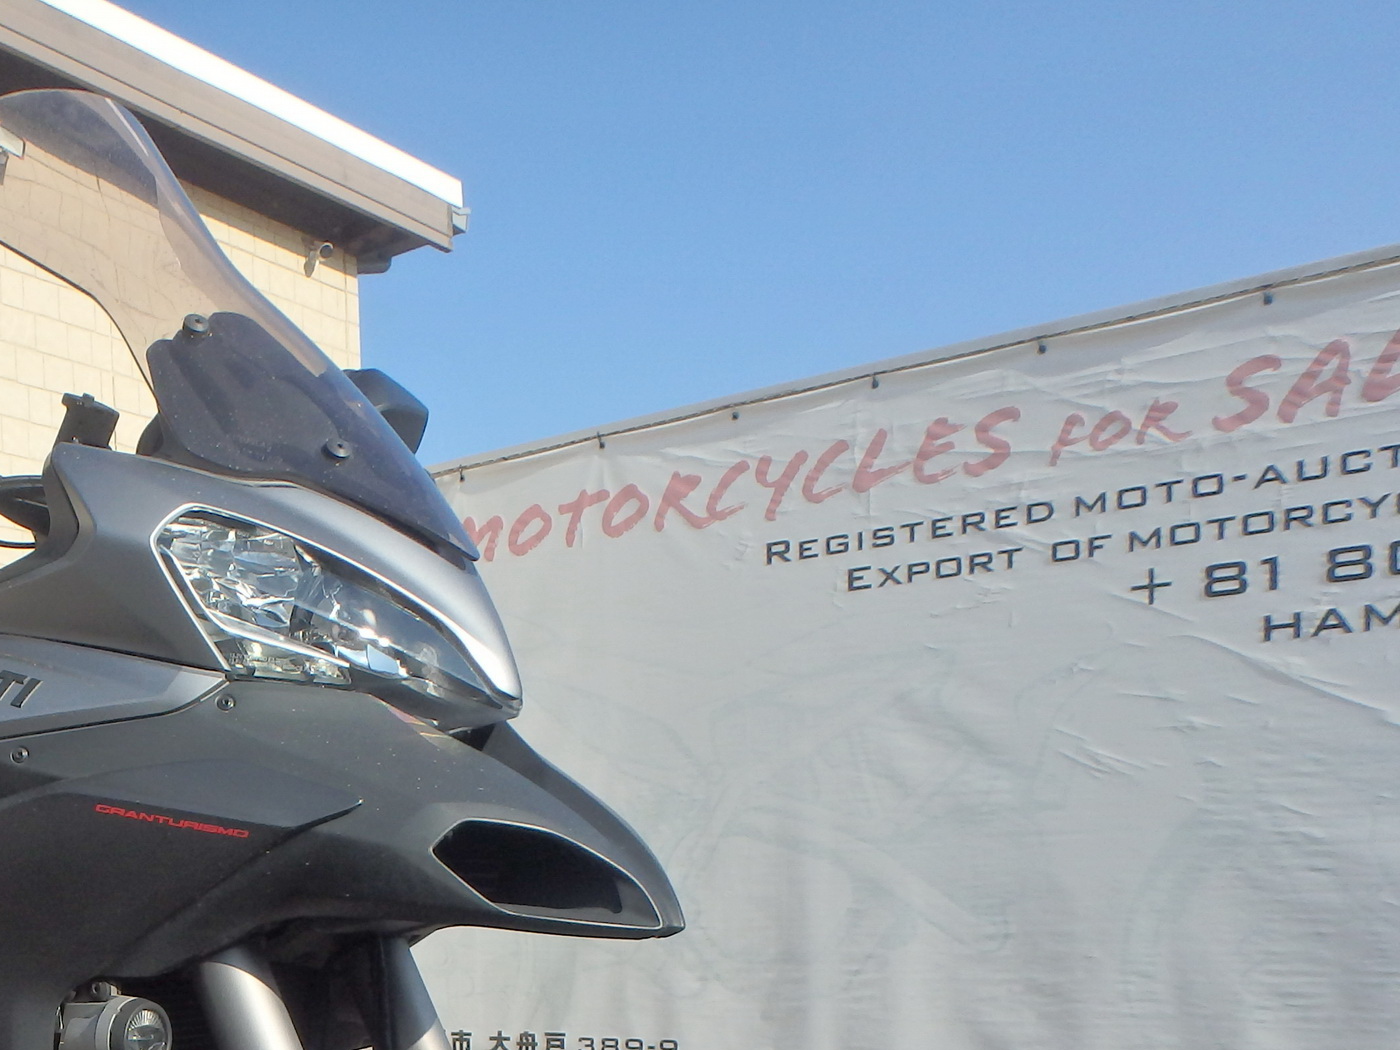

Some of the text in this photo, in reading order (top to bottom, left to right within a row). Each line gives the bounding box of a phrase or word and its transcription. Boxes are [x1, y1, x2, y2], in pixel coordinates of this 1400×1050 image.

[463, 406, 1021, 562] MOTORCYCLES
[766, 501, 1054, 565] REGISTERED
[847, 492, 1400, 592] EXPORT OF MOTORCY
[1204, 556, 1280, 598] 81
[95, 803, 250, 838] GRANTURISMO
